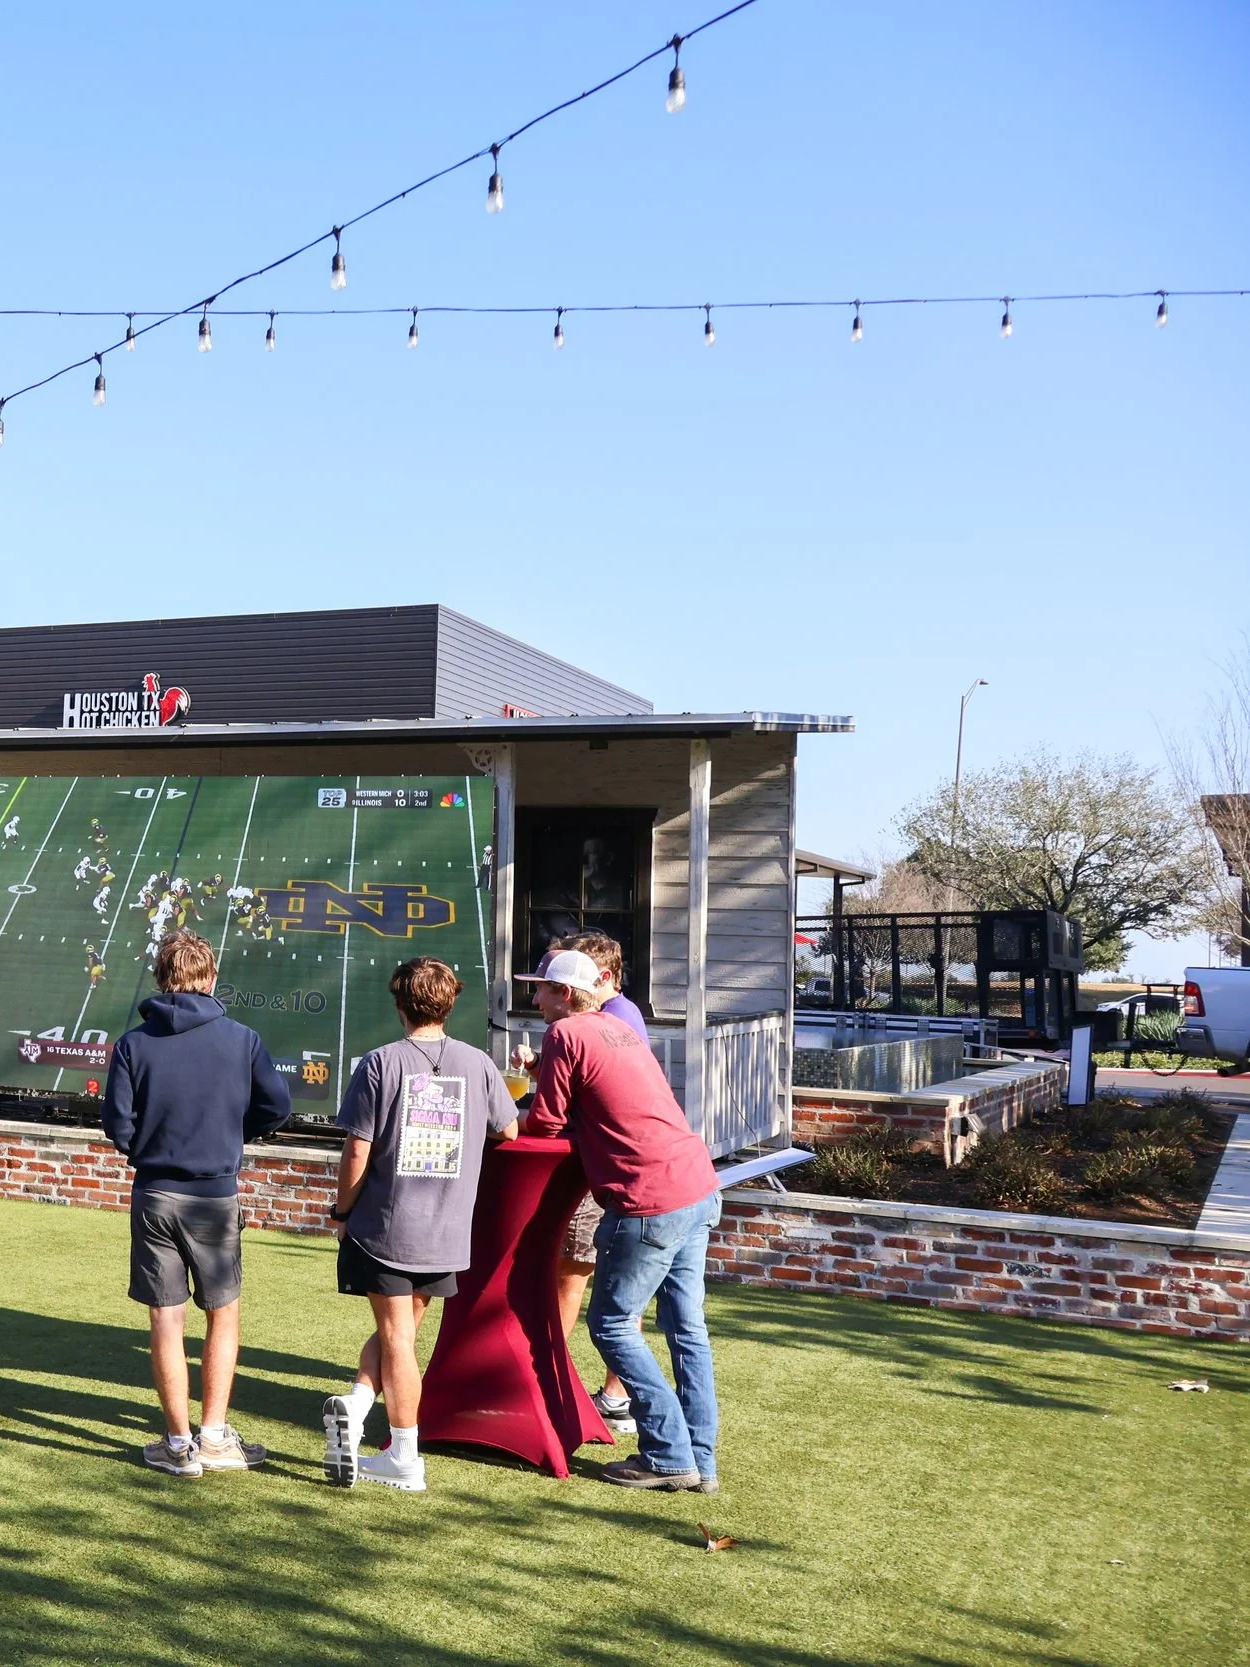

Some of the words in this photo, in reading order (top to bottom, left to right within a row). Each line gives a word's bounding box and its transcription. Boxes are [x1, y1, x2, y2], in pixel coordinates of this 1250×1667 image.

[63, 691, 138, 727] HOUSTON
[142, 691, 160, 711] TX
[101, 711, 160, 728] CHICKEN
[322, 789, 343, 798] TOP
[355, 790, 378, 798] WESTERN
[378, 790, 392, 798] MICH
[396, 789, 405, 798] 0
[413, 790, 429, 798] 3:03
[321, 797, 341, 807] 25
[355, 799, 382, 807] ILLINOIS
[394, 799, 406, 807] 10
[414, 799, 427, 807] 2nd
[270, 993, 288, 1011] &
[291, 989, 327, 1014] 10
[55, 1046, 84, 1056] TEXAS
[84, 1049, 106, 1058] A&M
[89, 1057, 106, 1065] 2-0
[273, 1063, 297, 1073] AME
[410, 1109, 440, 1124] SIGMA
